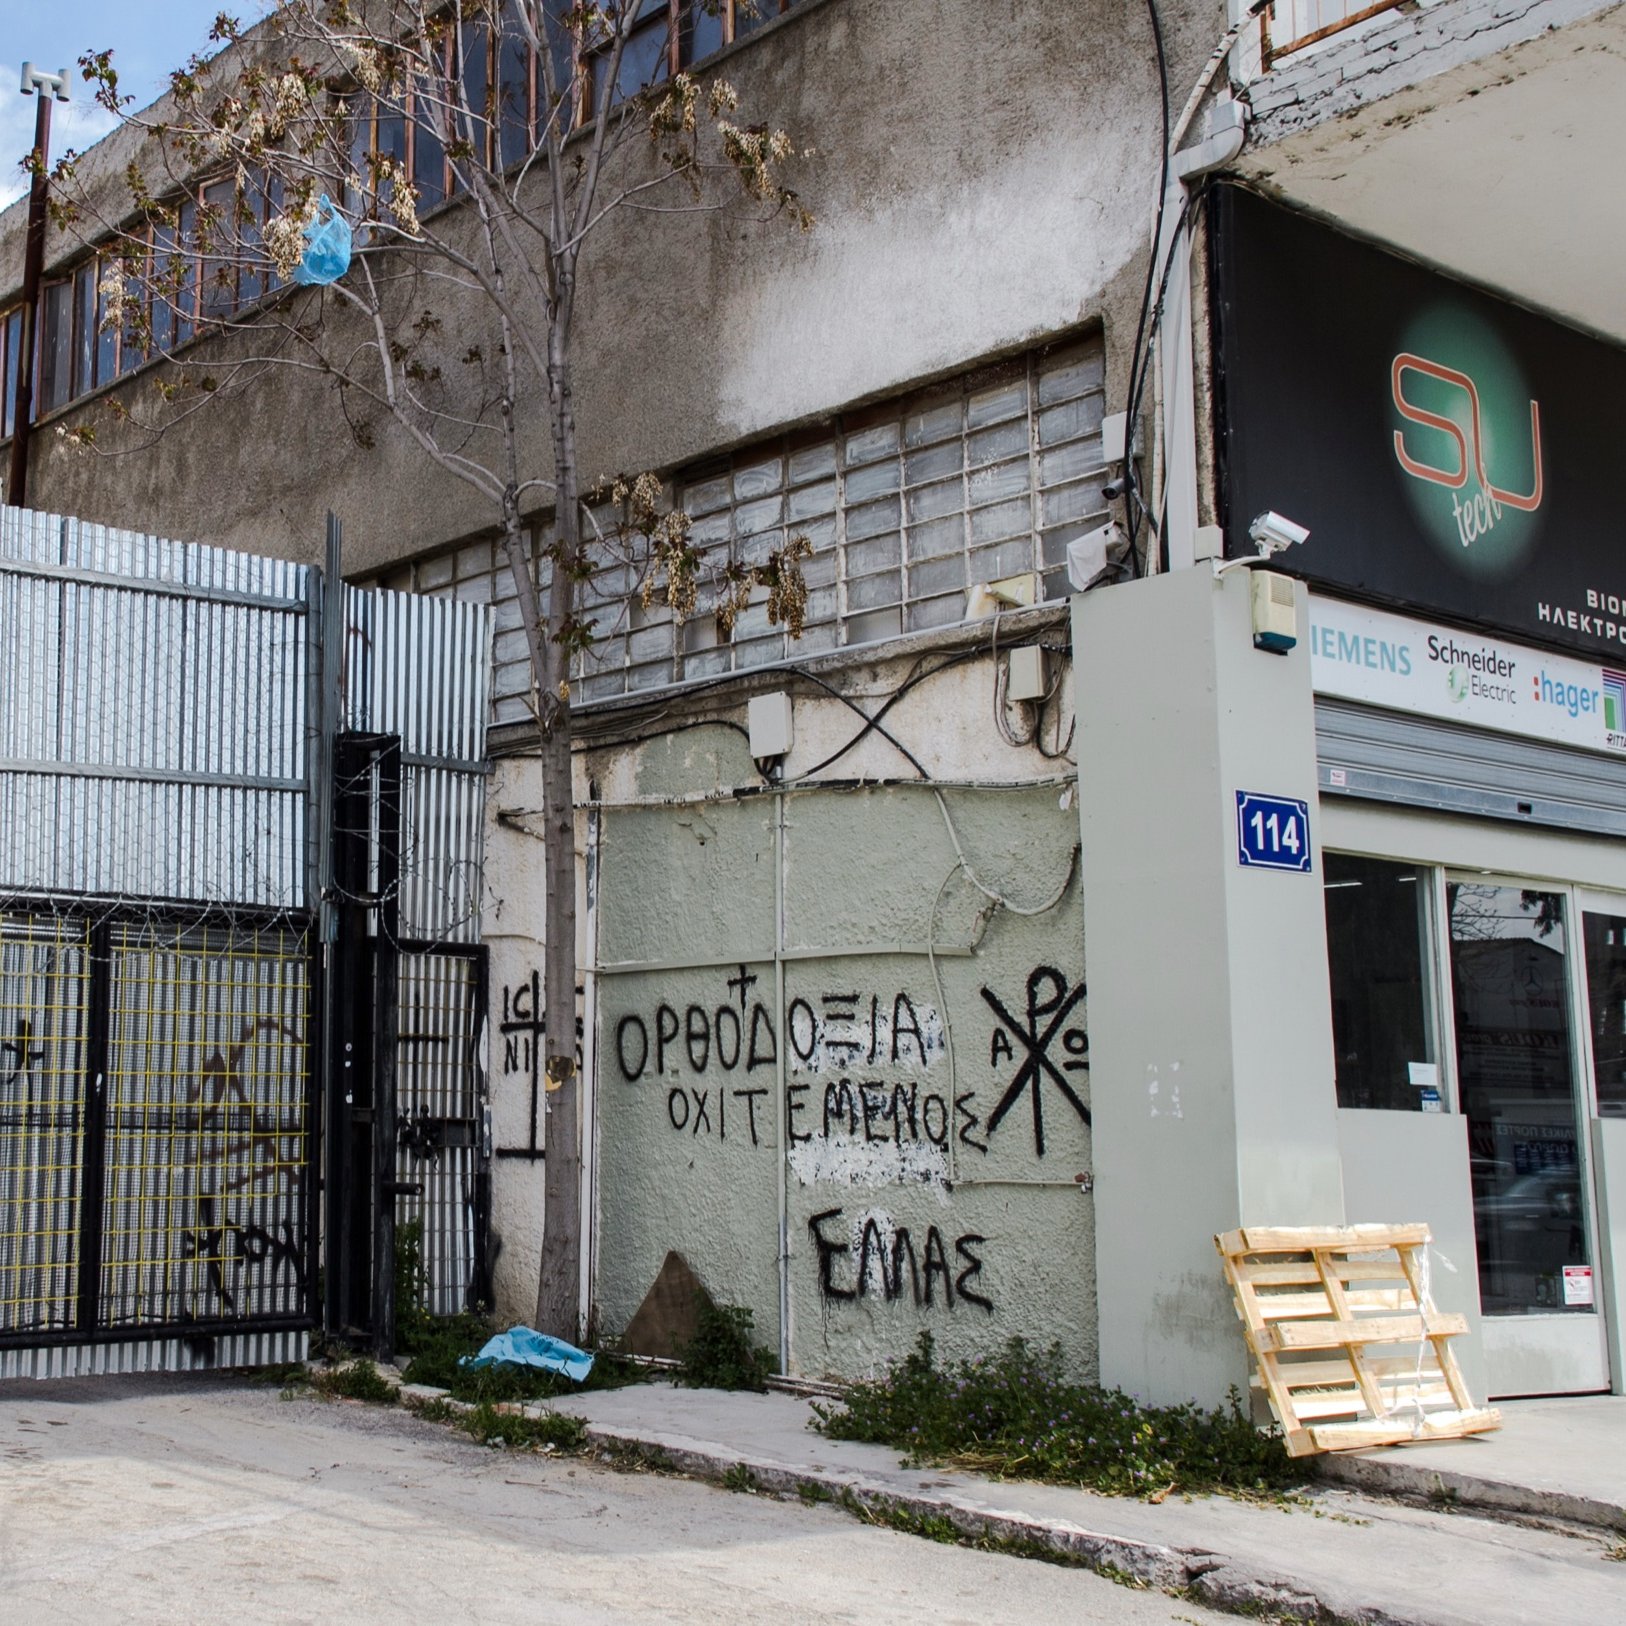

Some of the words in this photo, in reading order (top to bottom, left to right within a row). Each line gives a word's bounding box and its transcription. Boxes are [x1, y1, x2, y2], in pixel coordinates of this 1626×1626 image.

[1452, 463, 1502, 547] tech
[1311, 625, 1412, 676] IEMENS
[1428, 635, 1516, 679] Schneider
[1471, 675, 1517, 705] Electric
[1250, 811, 1300, 855] 114
